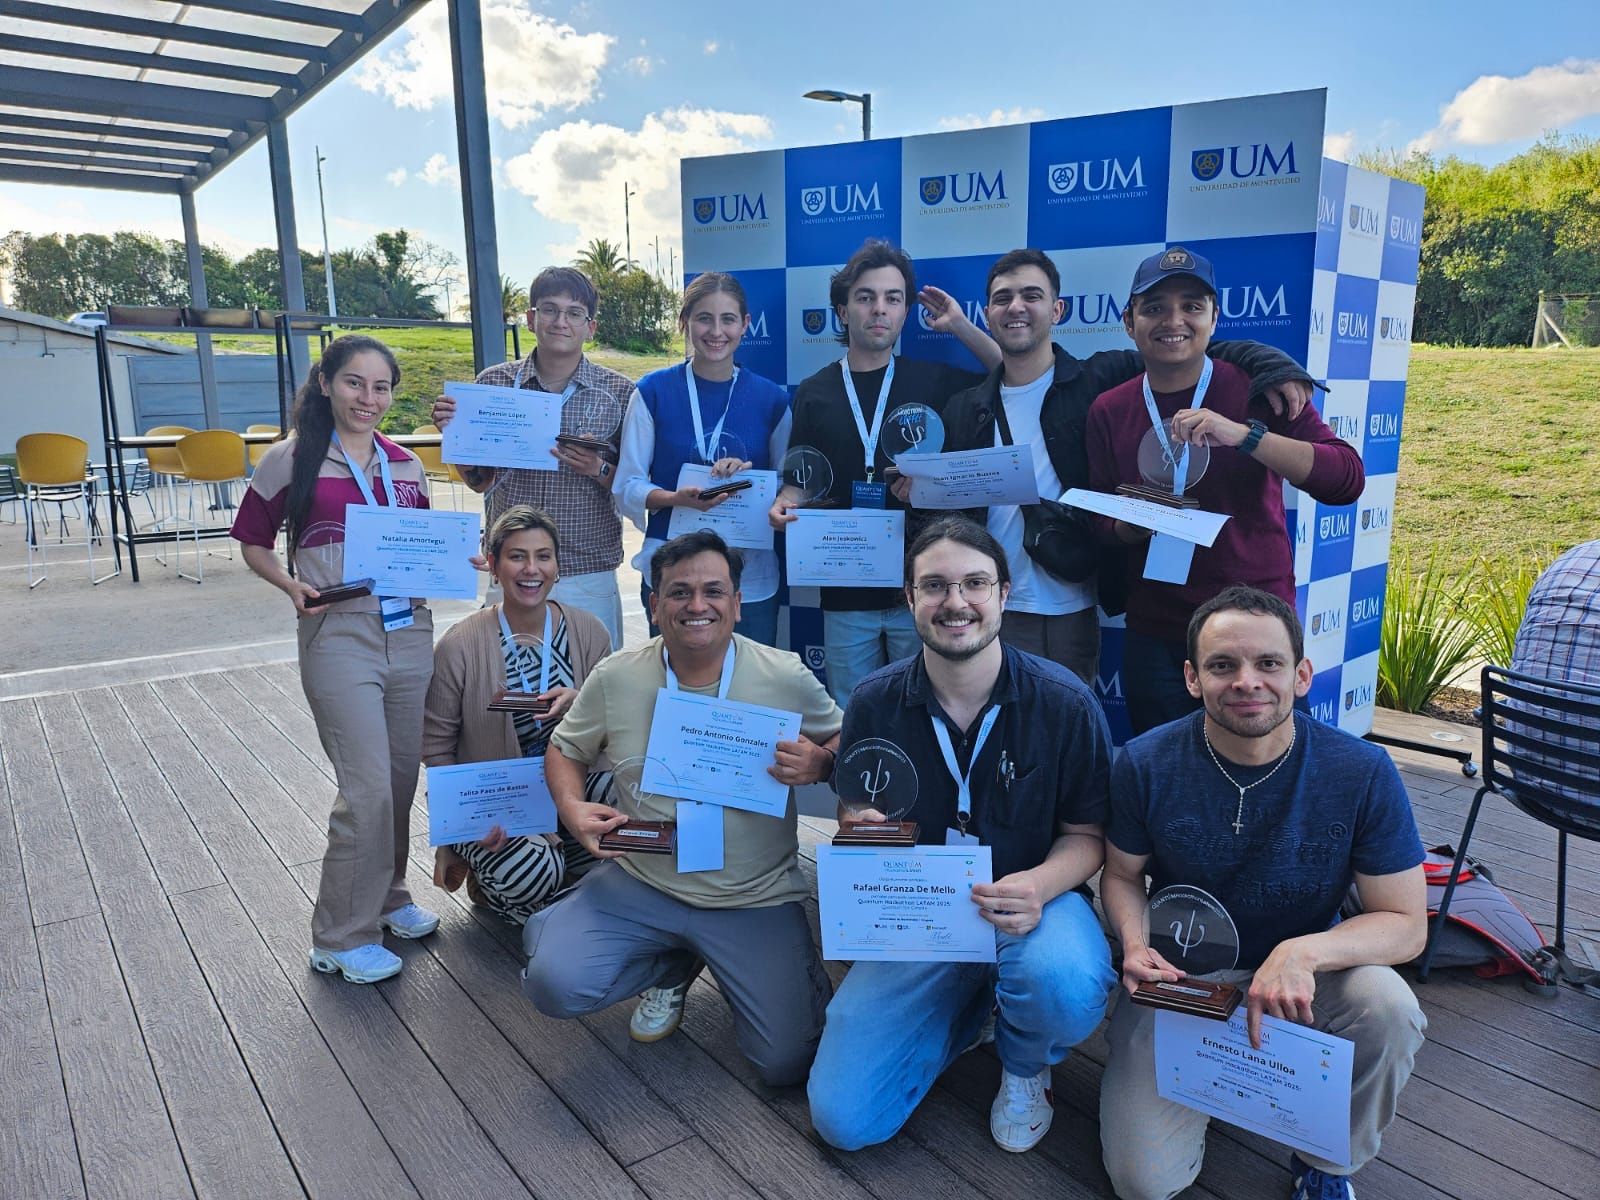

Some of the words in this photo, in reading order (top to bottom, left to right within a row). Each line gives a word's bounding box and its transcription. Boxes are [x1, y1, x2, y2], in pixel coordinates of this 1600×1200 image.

[1227, 140, 1301, 178] UM
[1081, 155, 1147, 191] UM
[1190, 182, 1238, 192] UNIVERSIDAD
[1250, 176, 1301, 186] MONTEVIDEO
[829, 181, 884, 214] UM
[948, 169, 1008, 203] UM
[719, 192, 769, 222] UM
[1360, 207, 1378, 236] UM
[1400, 217, 1417, 244] UM
[1219, 284, 1292, 318] UM
[1311, 309, 1324, 335] M
[1349, 312, 1368, 338] UM
[1389, 317, 1407, 341] UM
[1339, 415, 1358, 439] UM
[1380, 412, 1398, 436] UM
[1330, 513, 1350, 537] UM
[1371, 506, 1388, 528] UM
[382, 535, 408, 543] Natalia
[1297, 521, 1306, 543] M
[1362, 595, 1379, 619] UM
[1322, 608, 1341, 633] UM
[1354, 684, 1371, 707] UM
[680, 725, 703, 736] Pedro
[703, 730, 734, 741] Antonio
[735, 735, 768, 748] Gonzales
[853, 883, 881, 892] Rafael
[883, 884, 914, 893] Granza
[916, 885, 929, 893] De
[931, 886, 956, 894] Mello
[1196, 1050, 1224, 1065] Quantum
[1260, 1072, 1283, 1085] LATAM
[1202, 1036, 1240, 1056] Ernesto
[1242, 1050, 1266, 1066] Lana
[1269, 1060, 1296, 1076] Ulloa
